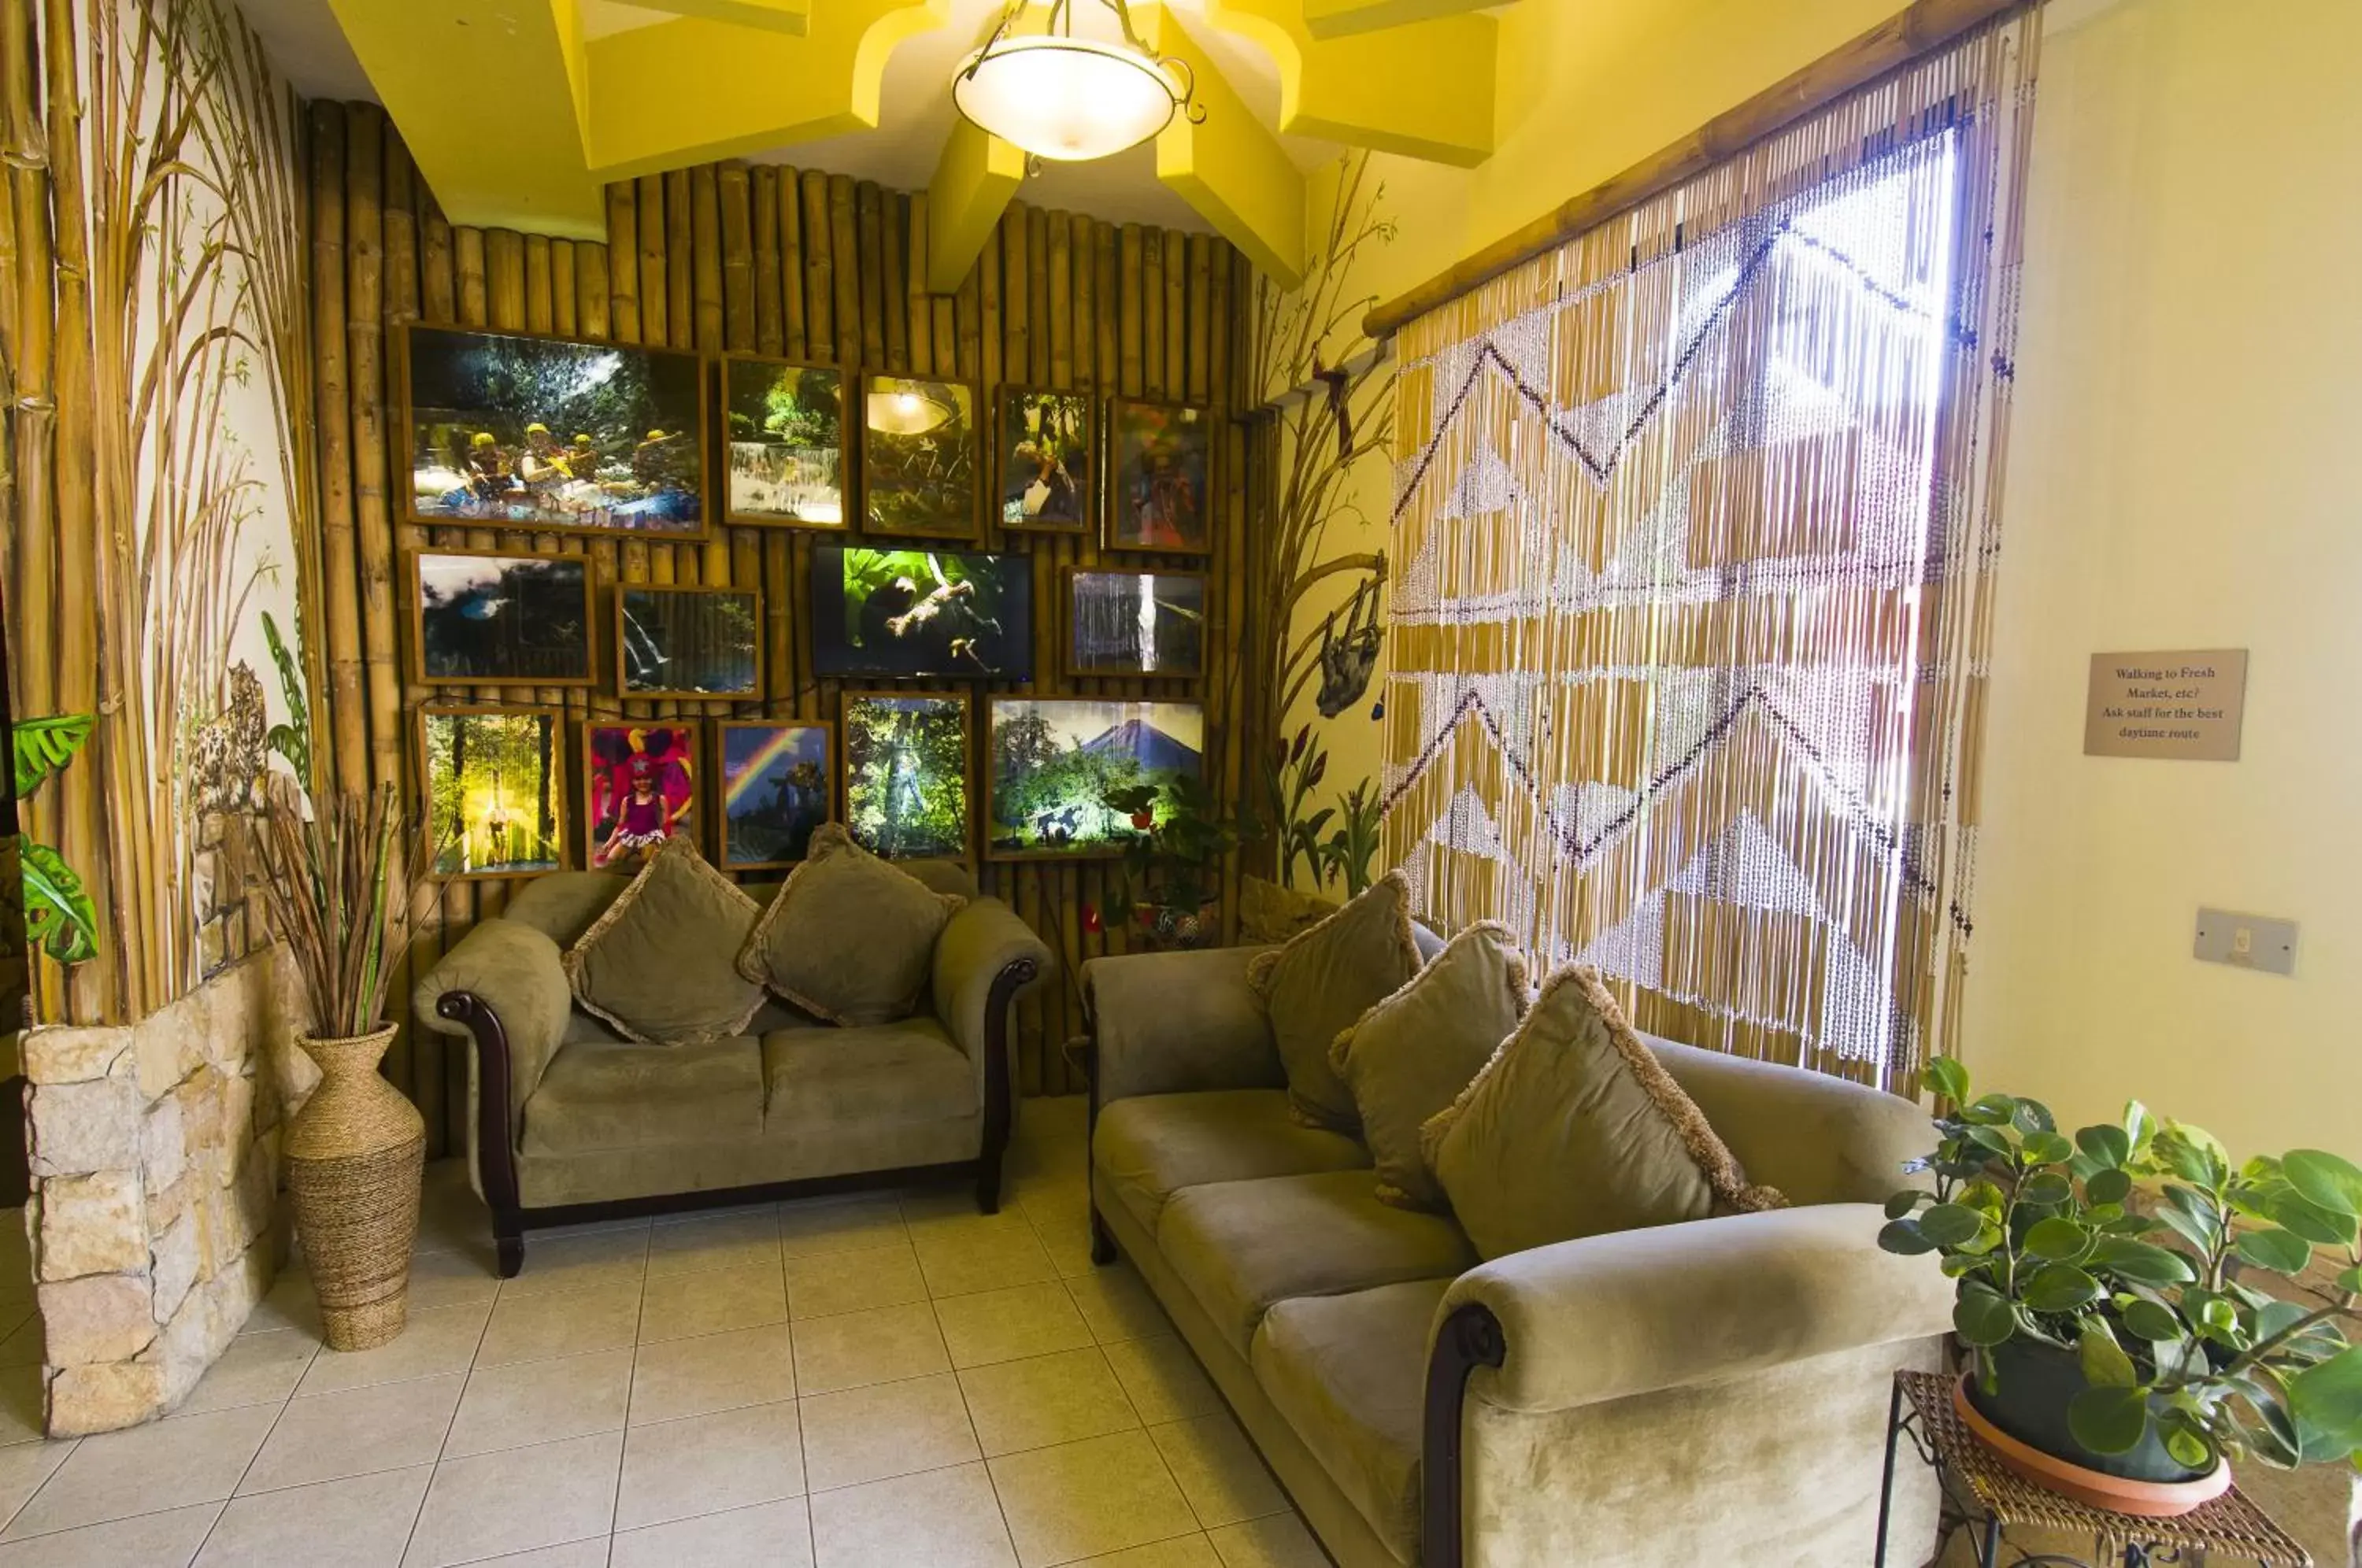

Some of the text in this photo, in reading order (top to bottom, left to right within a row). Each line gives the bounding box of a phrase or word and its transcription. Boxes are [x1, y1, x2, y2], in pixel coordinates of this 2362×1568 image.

[2116, 666, 2215, 680] Walking to Fresh
[2126, 687, 2172, 700] Market,
[2102, 708, 2223, 719] Ask staff for the best
[2119, 727, 2201, 740] daytime route
